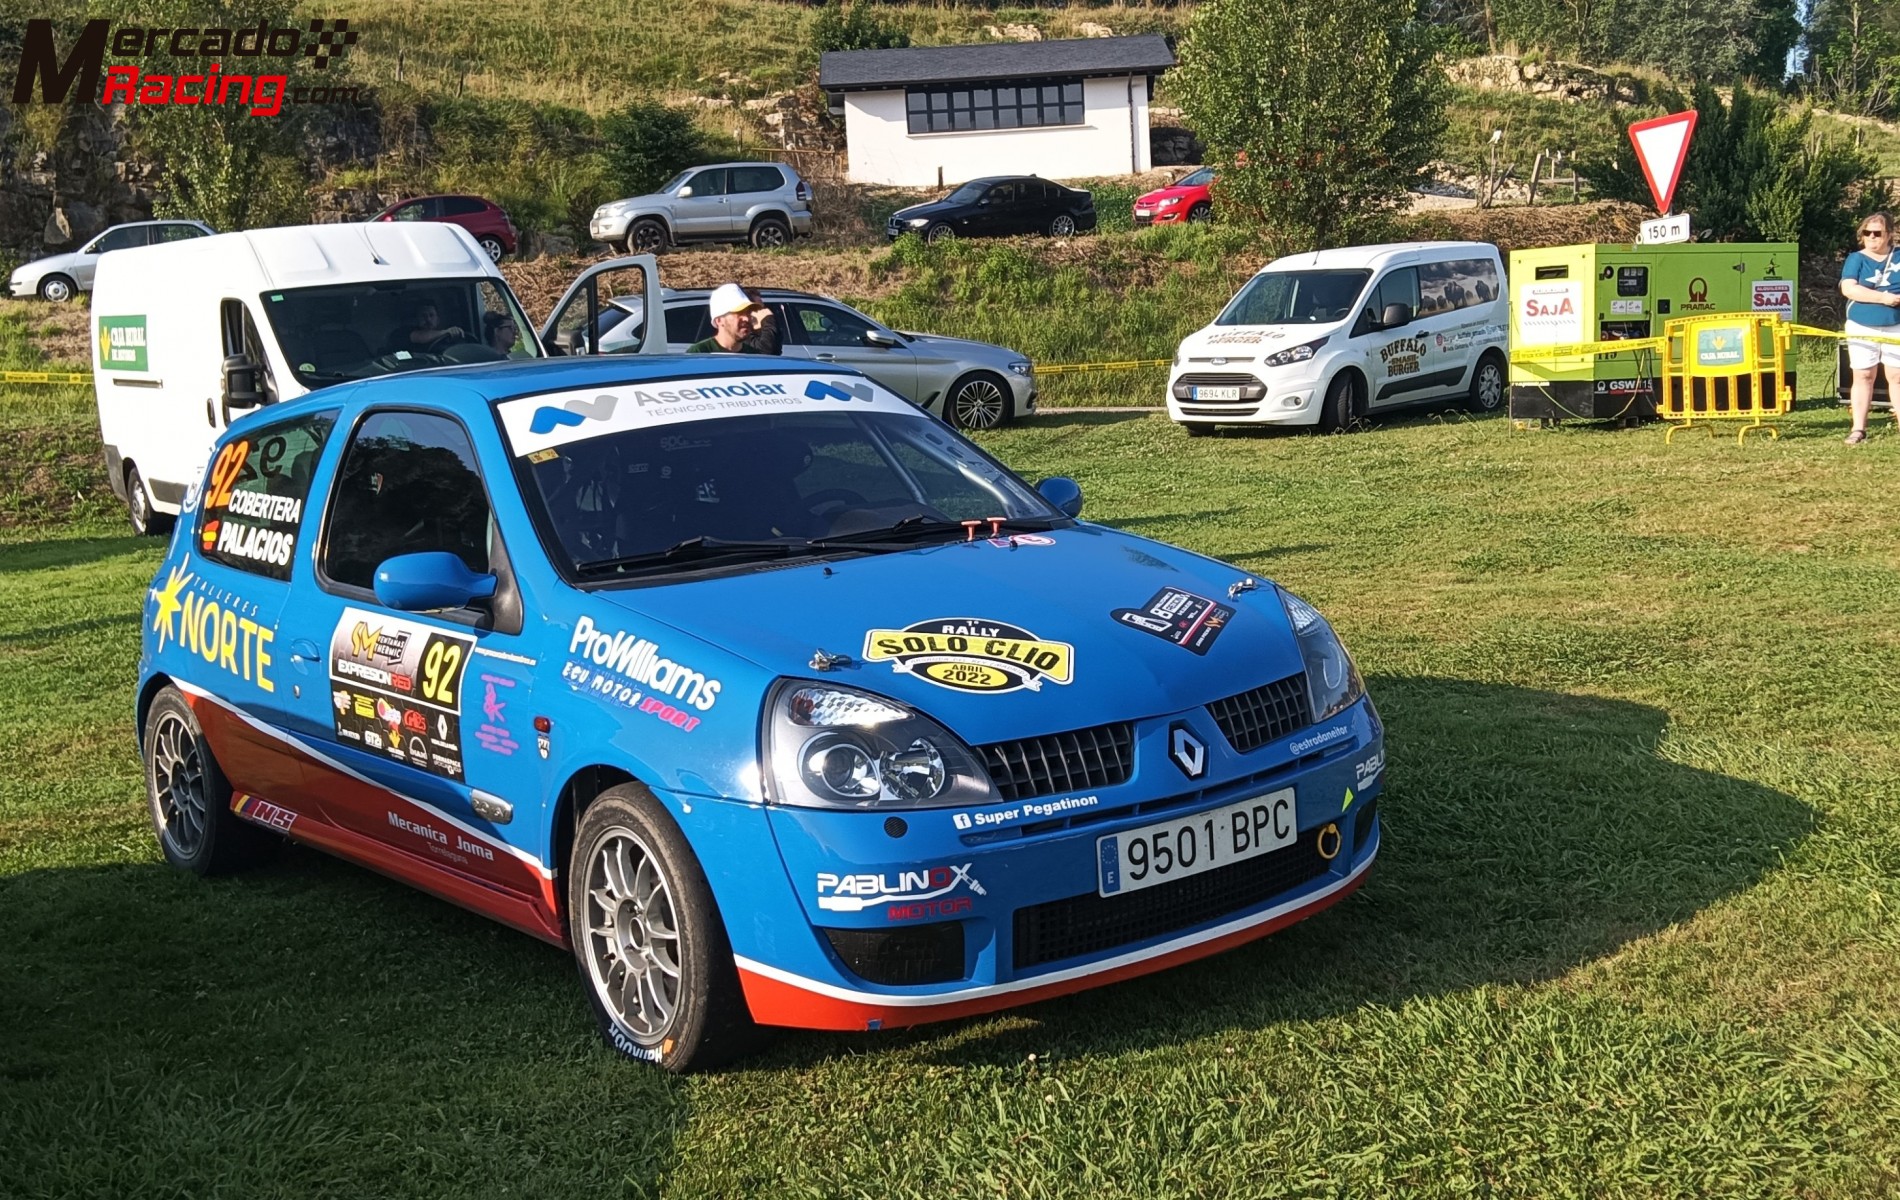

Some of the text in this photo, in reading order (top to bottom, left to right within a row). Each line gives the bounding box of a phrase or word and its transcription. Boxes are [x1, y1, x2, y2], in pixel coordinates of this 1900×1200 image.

[1648, 225, 1680, 239] 150 m
[1680, 303, 1716, 311] PRAMAC
[1380, 337, 1427, 363] BUFFALO
[1387, 361, 1420, 377] BURGER
[634, 381, 787, 407] Asemolar
[1199, 389, 1237, 398] 9694 KLR
[1609, 381, 1636, 390] GSW
[718, 397, 803, 410] TRIBUTARIOS
[204, 441, 249, 510] 92
[228, 489, 301, 523] COBERTERA
[217, 522, 294, 565] PALACIOS
[193, 576, 258, 617] TALLERES
[180, 591, 274, 693] NORTE
[377, 635, 405, 648] VENTANAS
[942, 624, 1000, 638] RALLY
[569, 615, 722, 711] ProWilliams
[877, 636, 1060, 671] SOLO CLIO
[422, 641, 461, 703] 92
[943, 669, 992, 685] 2022
[952, 664, 984, 673] ABRIL
[562, 661, 701, 732] ECU MOTOR SPORT
[1289, 725, 1348, 755] @estradaneitor
[974, 795, 1099, 826] Super Pegatinon
[388, 811, 494, 862] Mecanica Joma
[1127, 799, 1290, 881] 9501 BPC
[817, 863, 974, 894] PABLINOX
[1107, 871, 1115, 884] E
[888, 897, 973, 920] MOTOR
